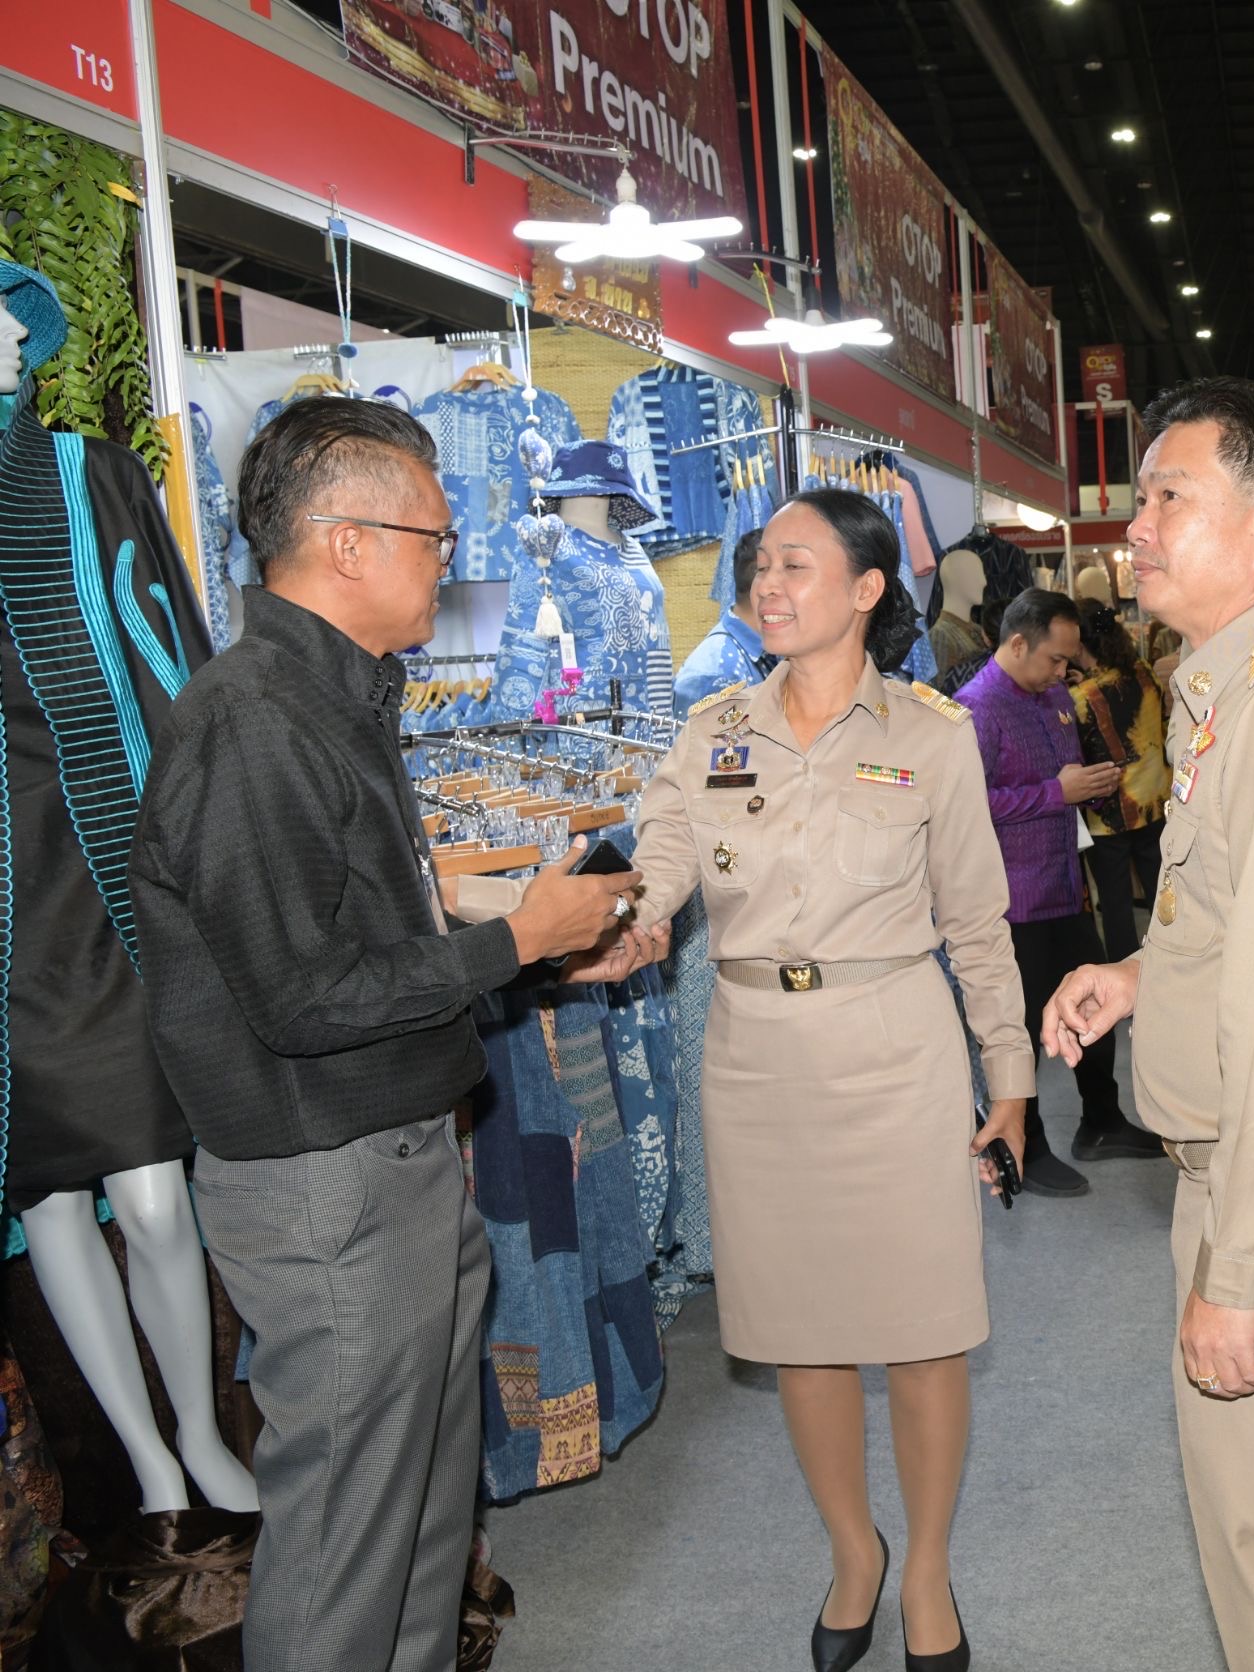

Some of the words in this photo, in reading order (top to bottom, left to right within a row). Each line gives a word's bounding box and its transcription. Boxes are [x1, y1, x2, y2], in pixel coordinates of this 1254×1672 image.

[71, 44, 113, 92] T13
[604, 0, 711, 79] OP
[550, 9, 724, 198] Premium
[902, 214, 941, 289] OTOP
[890, 276, 946, 360] Premium
[1096, 383, 1113, 401] S
